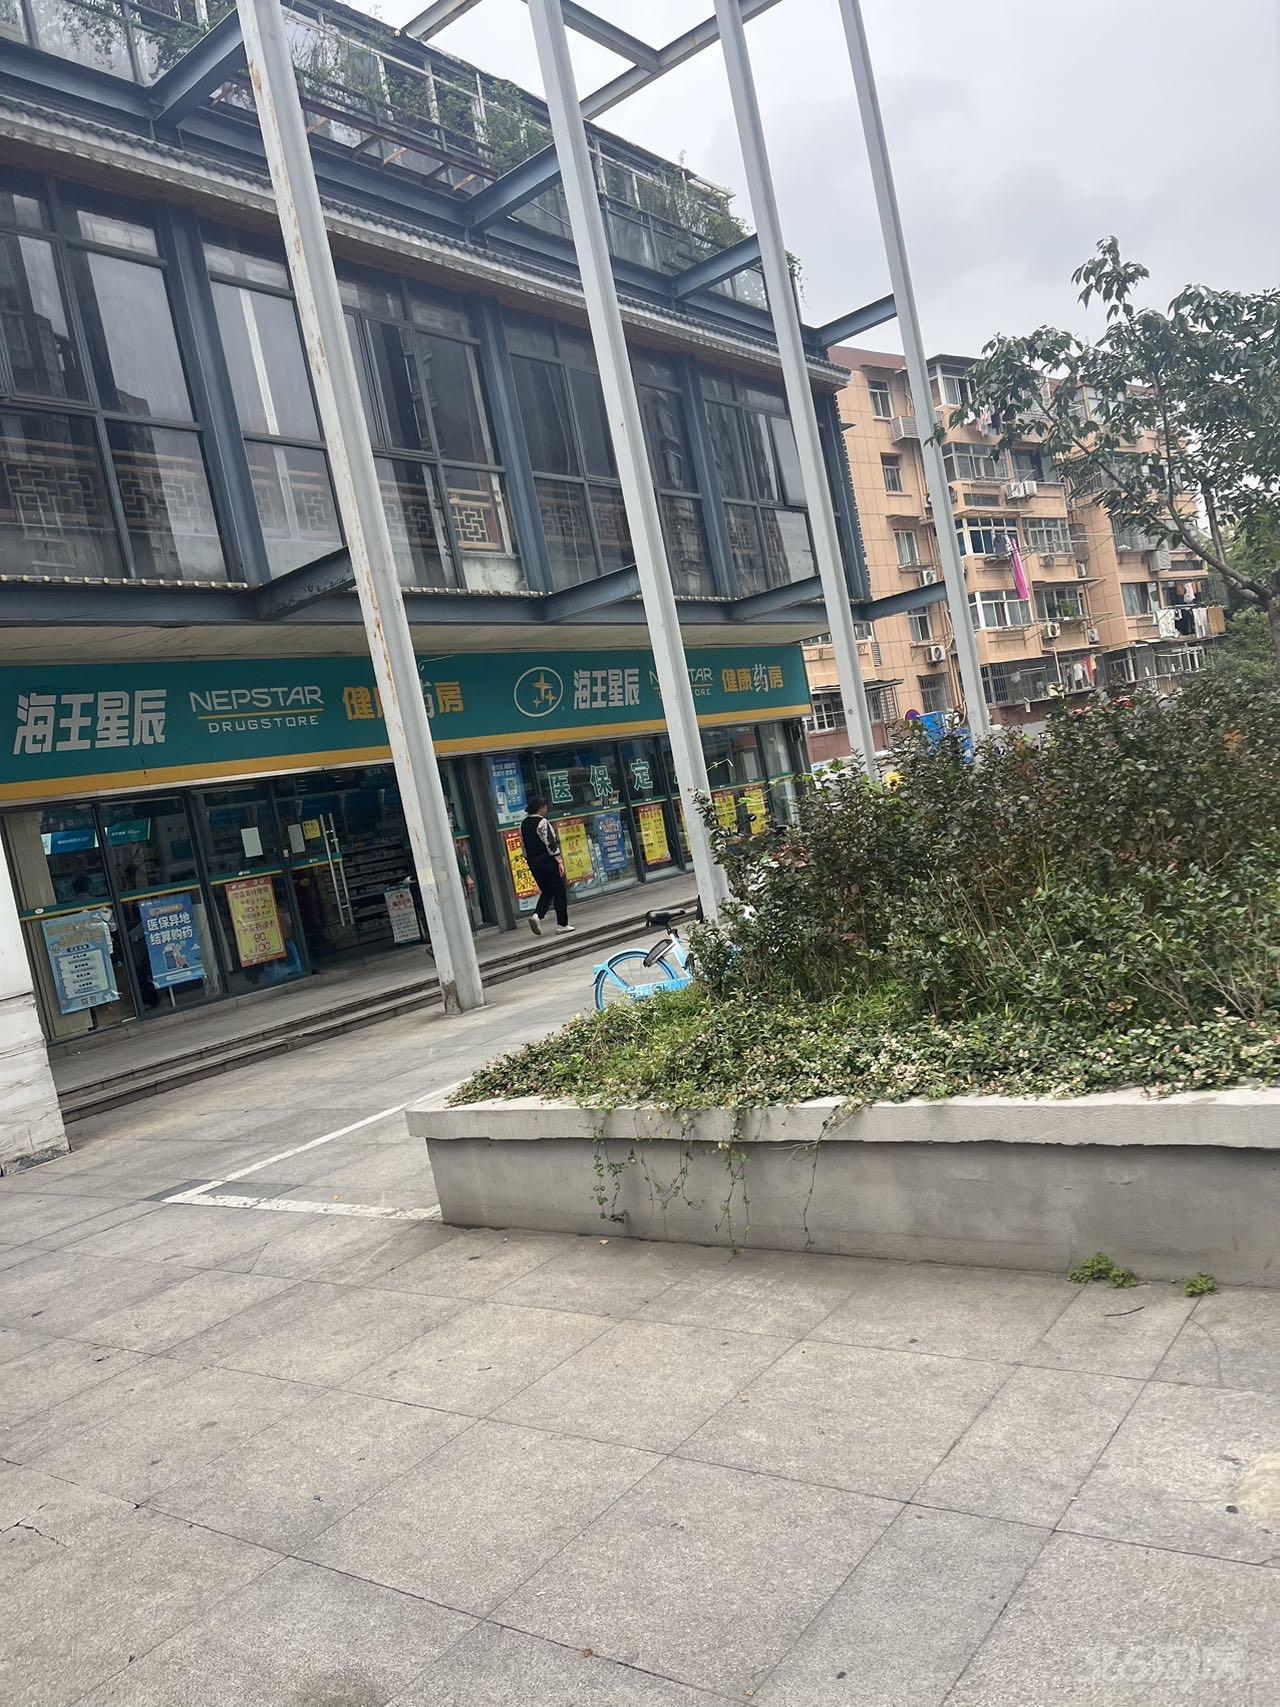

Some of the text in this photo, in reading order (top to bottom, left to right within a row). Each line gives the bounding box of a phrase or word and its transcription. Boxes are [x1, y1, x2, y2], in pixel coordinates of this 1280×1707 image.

[574, 668, 640, 709] 海王星辰
[721, 663, 785, 693] 健康药房
[188, 685, 324, 712] NEPSTAR
[13, 689, 167, 755] 海王星辰
[208, 715, 319, 733] DRUGSTORE
[548, 758, 678, 804] 医保定
[147, 911, 192, 932] 医保异地
[150, 925, 193, 946] 结算购药
